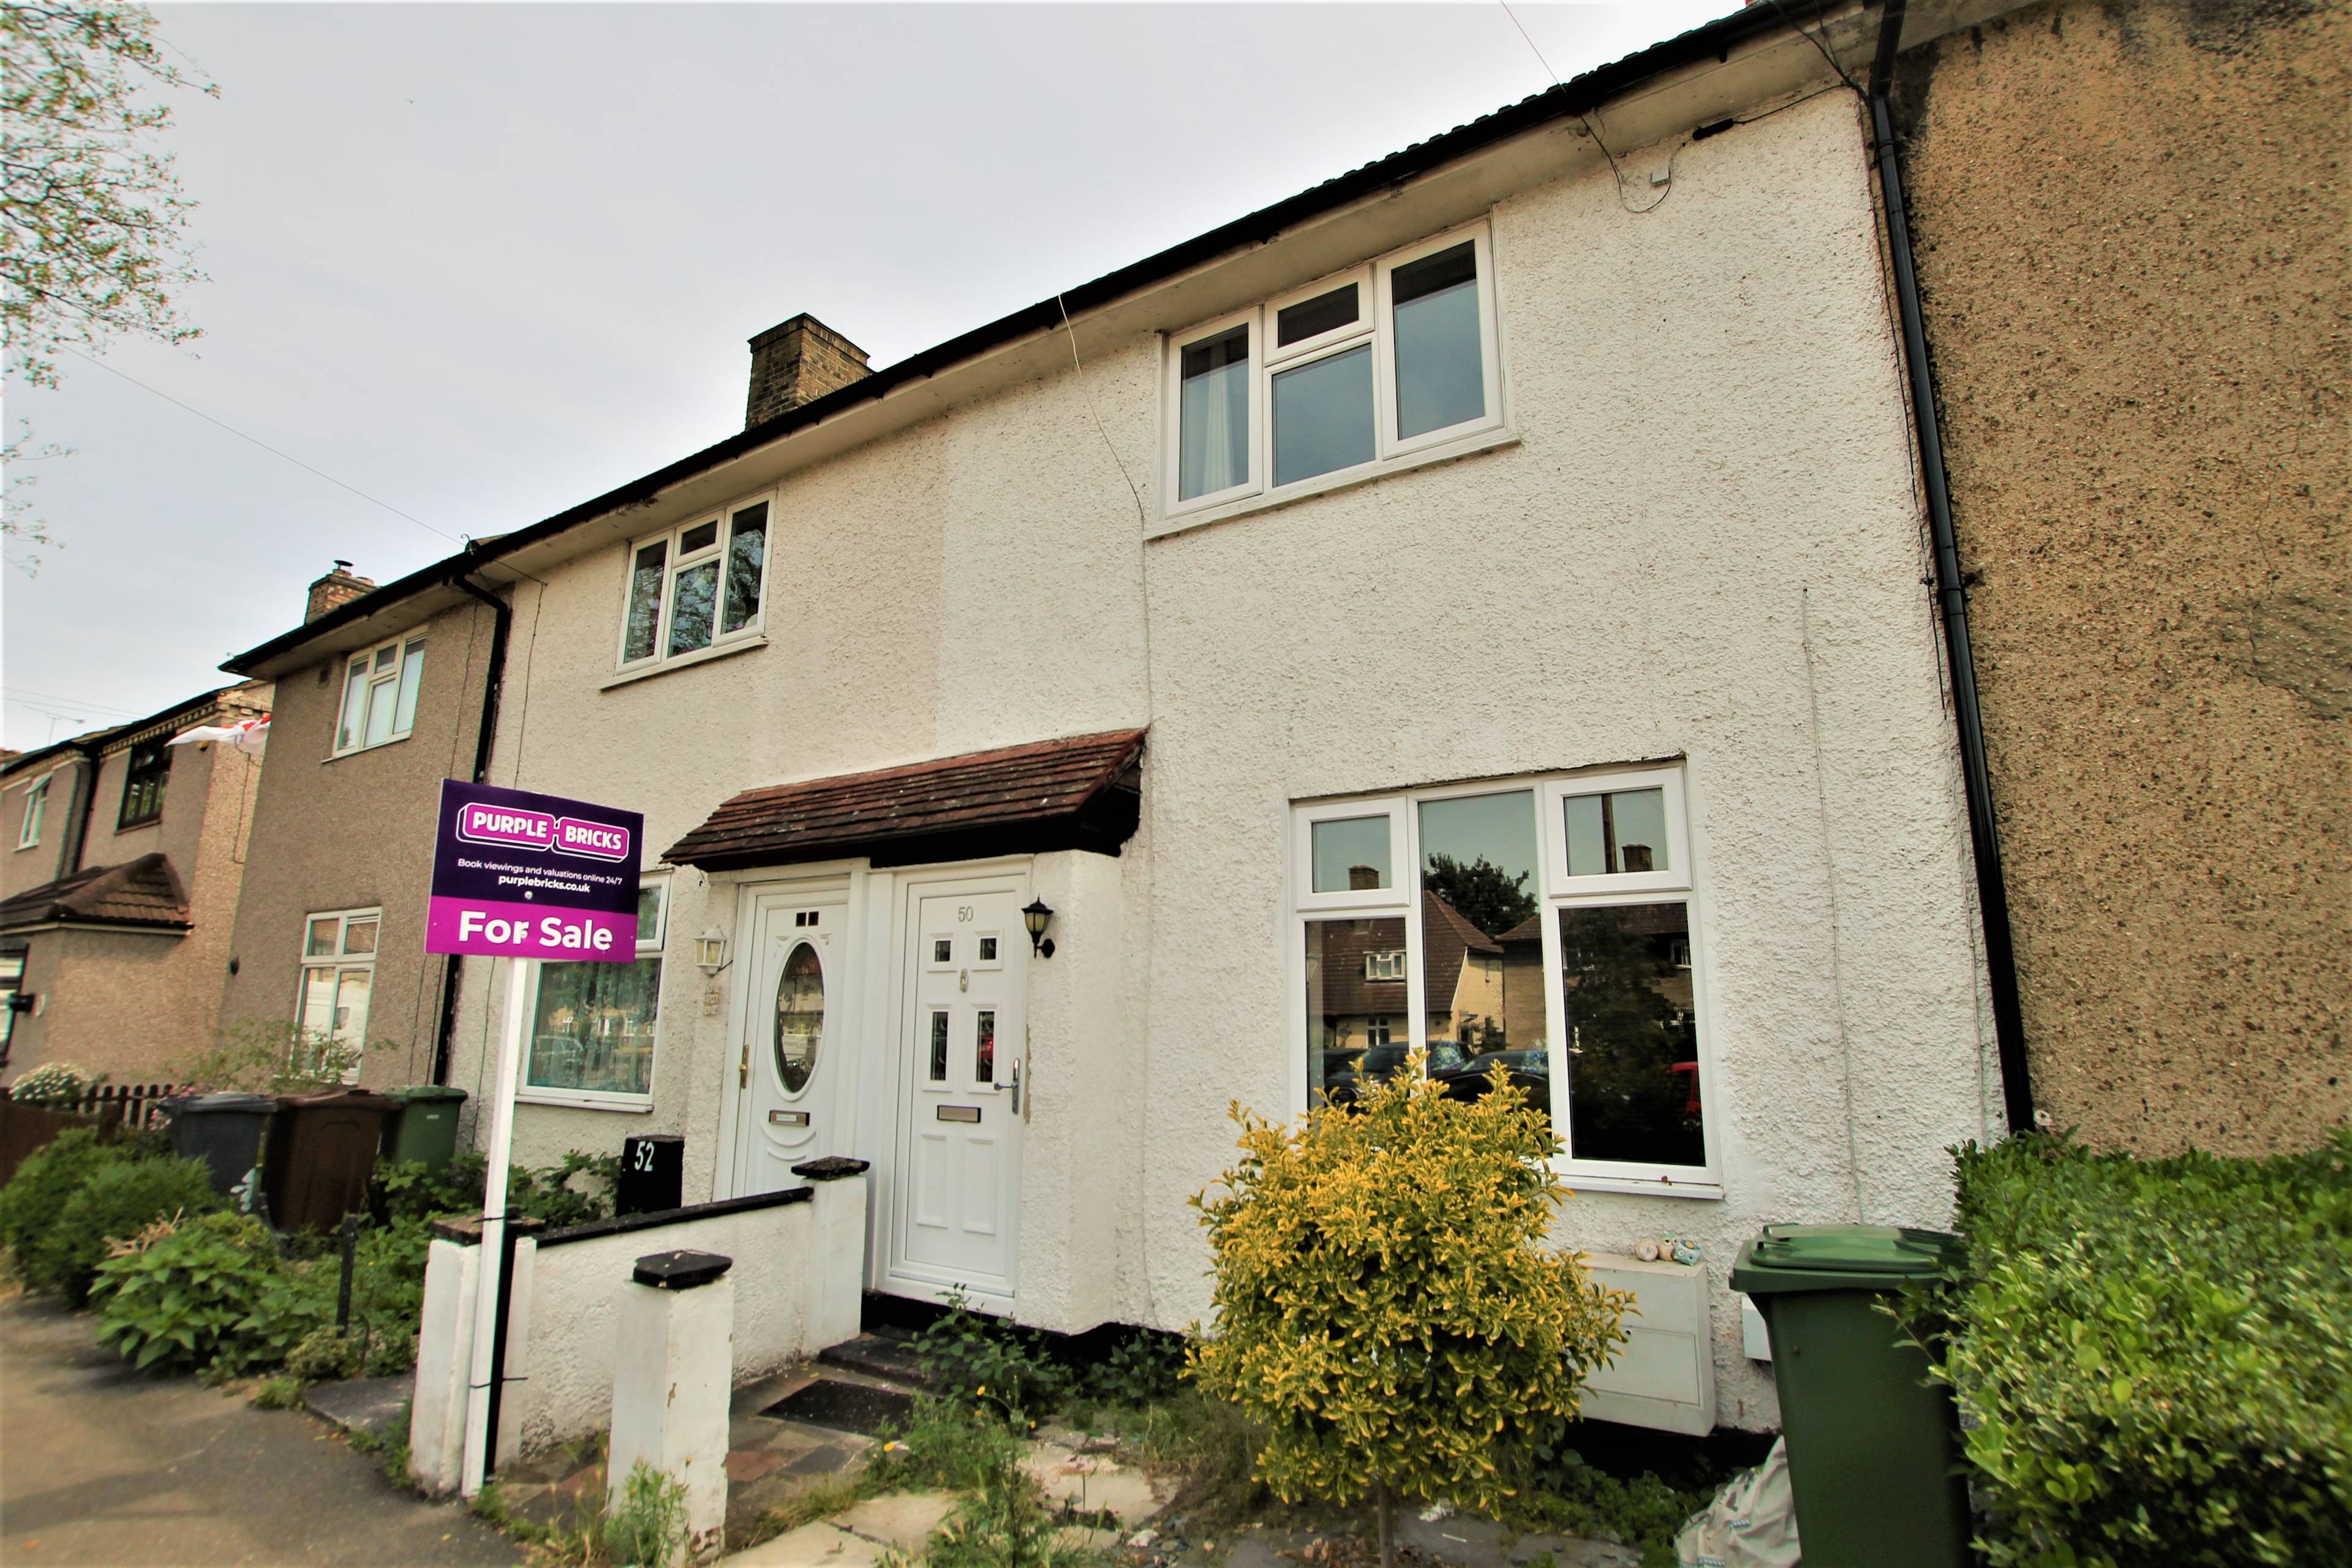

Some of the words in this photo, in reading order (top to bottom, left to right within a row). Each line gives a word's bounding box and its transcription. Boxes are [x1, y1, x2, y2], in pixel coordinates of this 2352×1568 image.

[472, 811, 548, 838] PURPLE
[565, 825, 622, 850] BRICKS
[458, 858, 482, 868] Book
[484, 861, 524, 873] viewings
[525, 867, 541, 875] and
[543, 869, 582, 880] valuations
[582, 873, 605, 883] online
[606, 876, 622, 885] 24/7
[498, 875, 590, 892] purplebricks.co.uk
[958, 906, 973, 922] 50
[459, 910, 529, 944] For
[539, 916, 612, 951] Sale
[634, 1140, 655, 1172] 52
